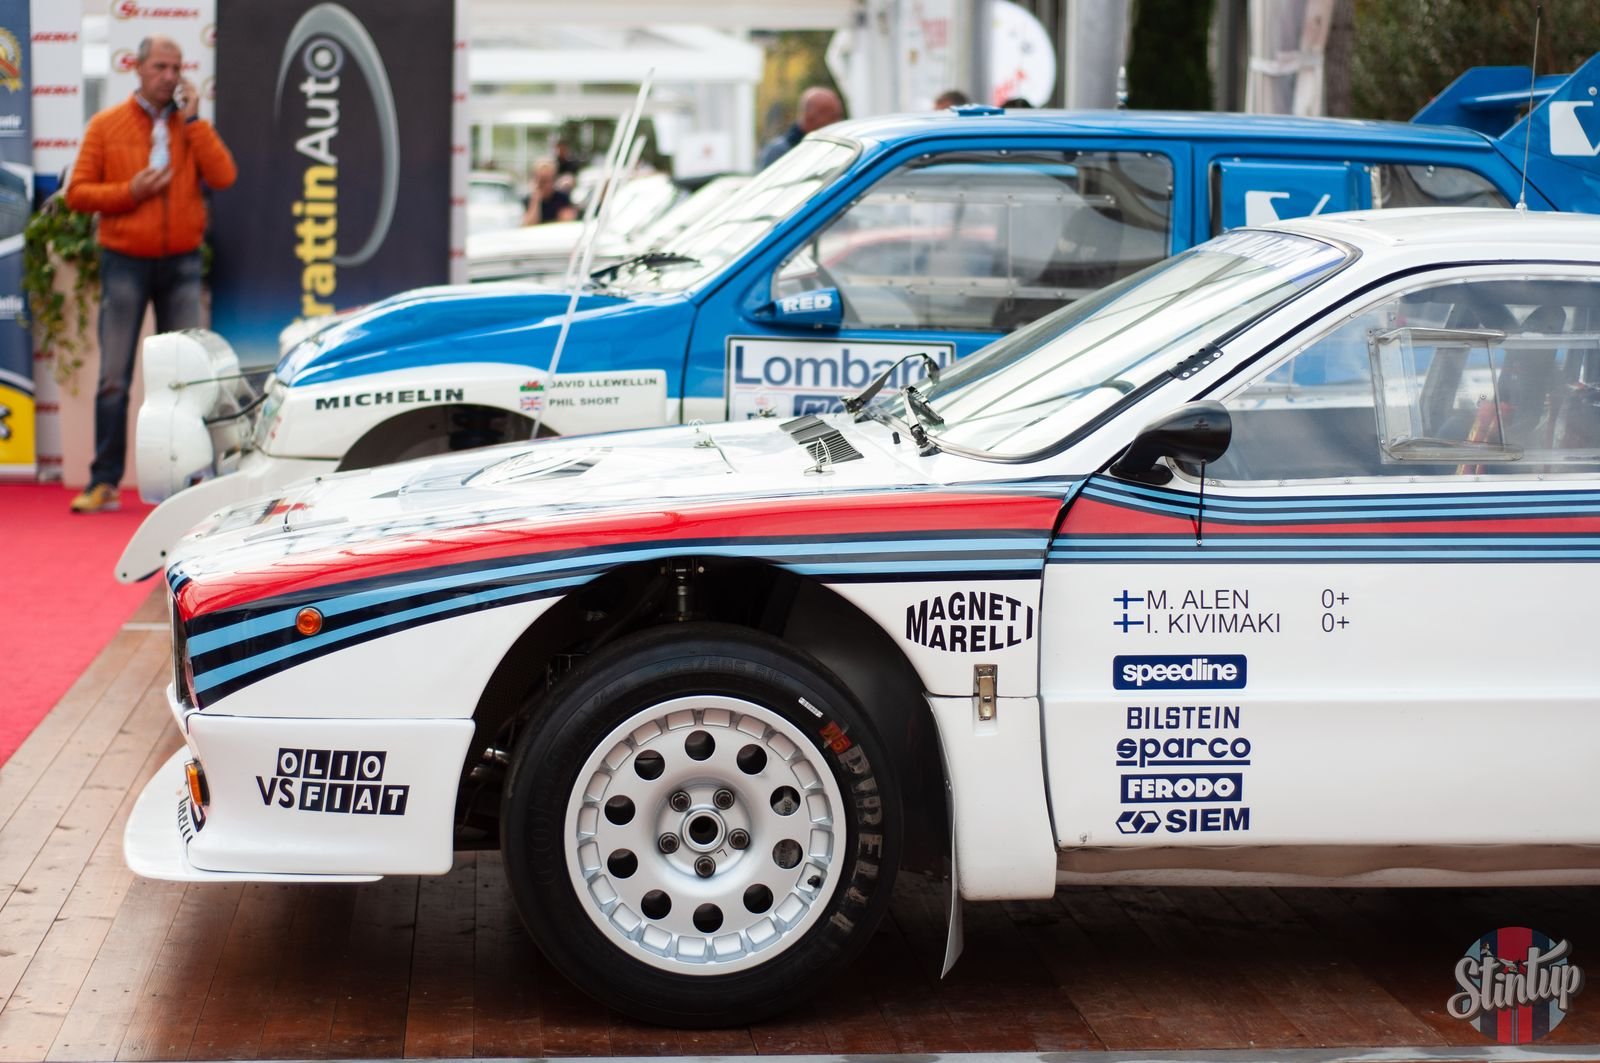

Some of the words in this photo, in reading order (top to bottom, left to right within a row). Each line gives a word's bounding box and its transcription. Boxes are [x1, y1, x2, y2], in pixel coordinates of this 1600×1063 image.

[291, 37, 344, 322] rattinAuto
[782, 294, 833, 313] RED
[589, 377, 657, 388] LLEWELLIN
[315, 388, 464, 410] MICHELIN
[549, 397, 576, 407] PHIL
[580, 396, 620, 407] SHORT
[1147, 589, 1174, 610] M.
[1181, 589, 1249, 610] ALEN
[906, 591, 1033, 640] MAGNETI
[1146, 613, 1159, 634] I.
[1168, 613, 1281, 633] KIVIMAKI
[906, 604, 1033, 653] MARELLI
[1122, 658, 1238, 687] speedline
[1126, 706, 1240, 730] BILSTEIN
[278, 750, 384, 780] OLIO
[1116, 737, 1252, 768] sparco
[256, 776, 295, 809] VS
[302, 783, 406, 814] FIAT
[1127, 778, 1236, 799] FERODO
[1165, 807, 1250, 833] SIEM
